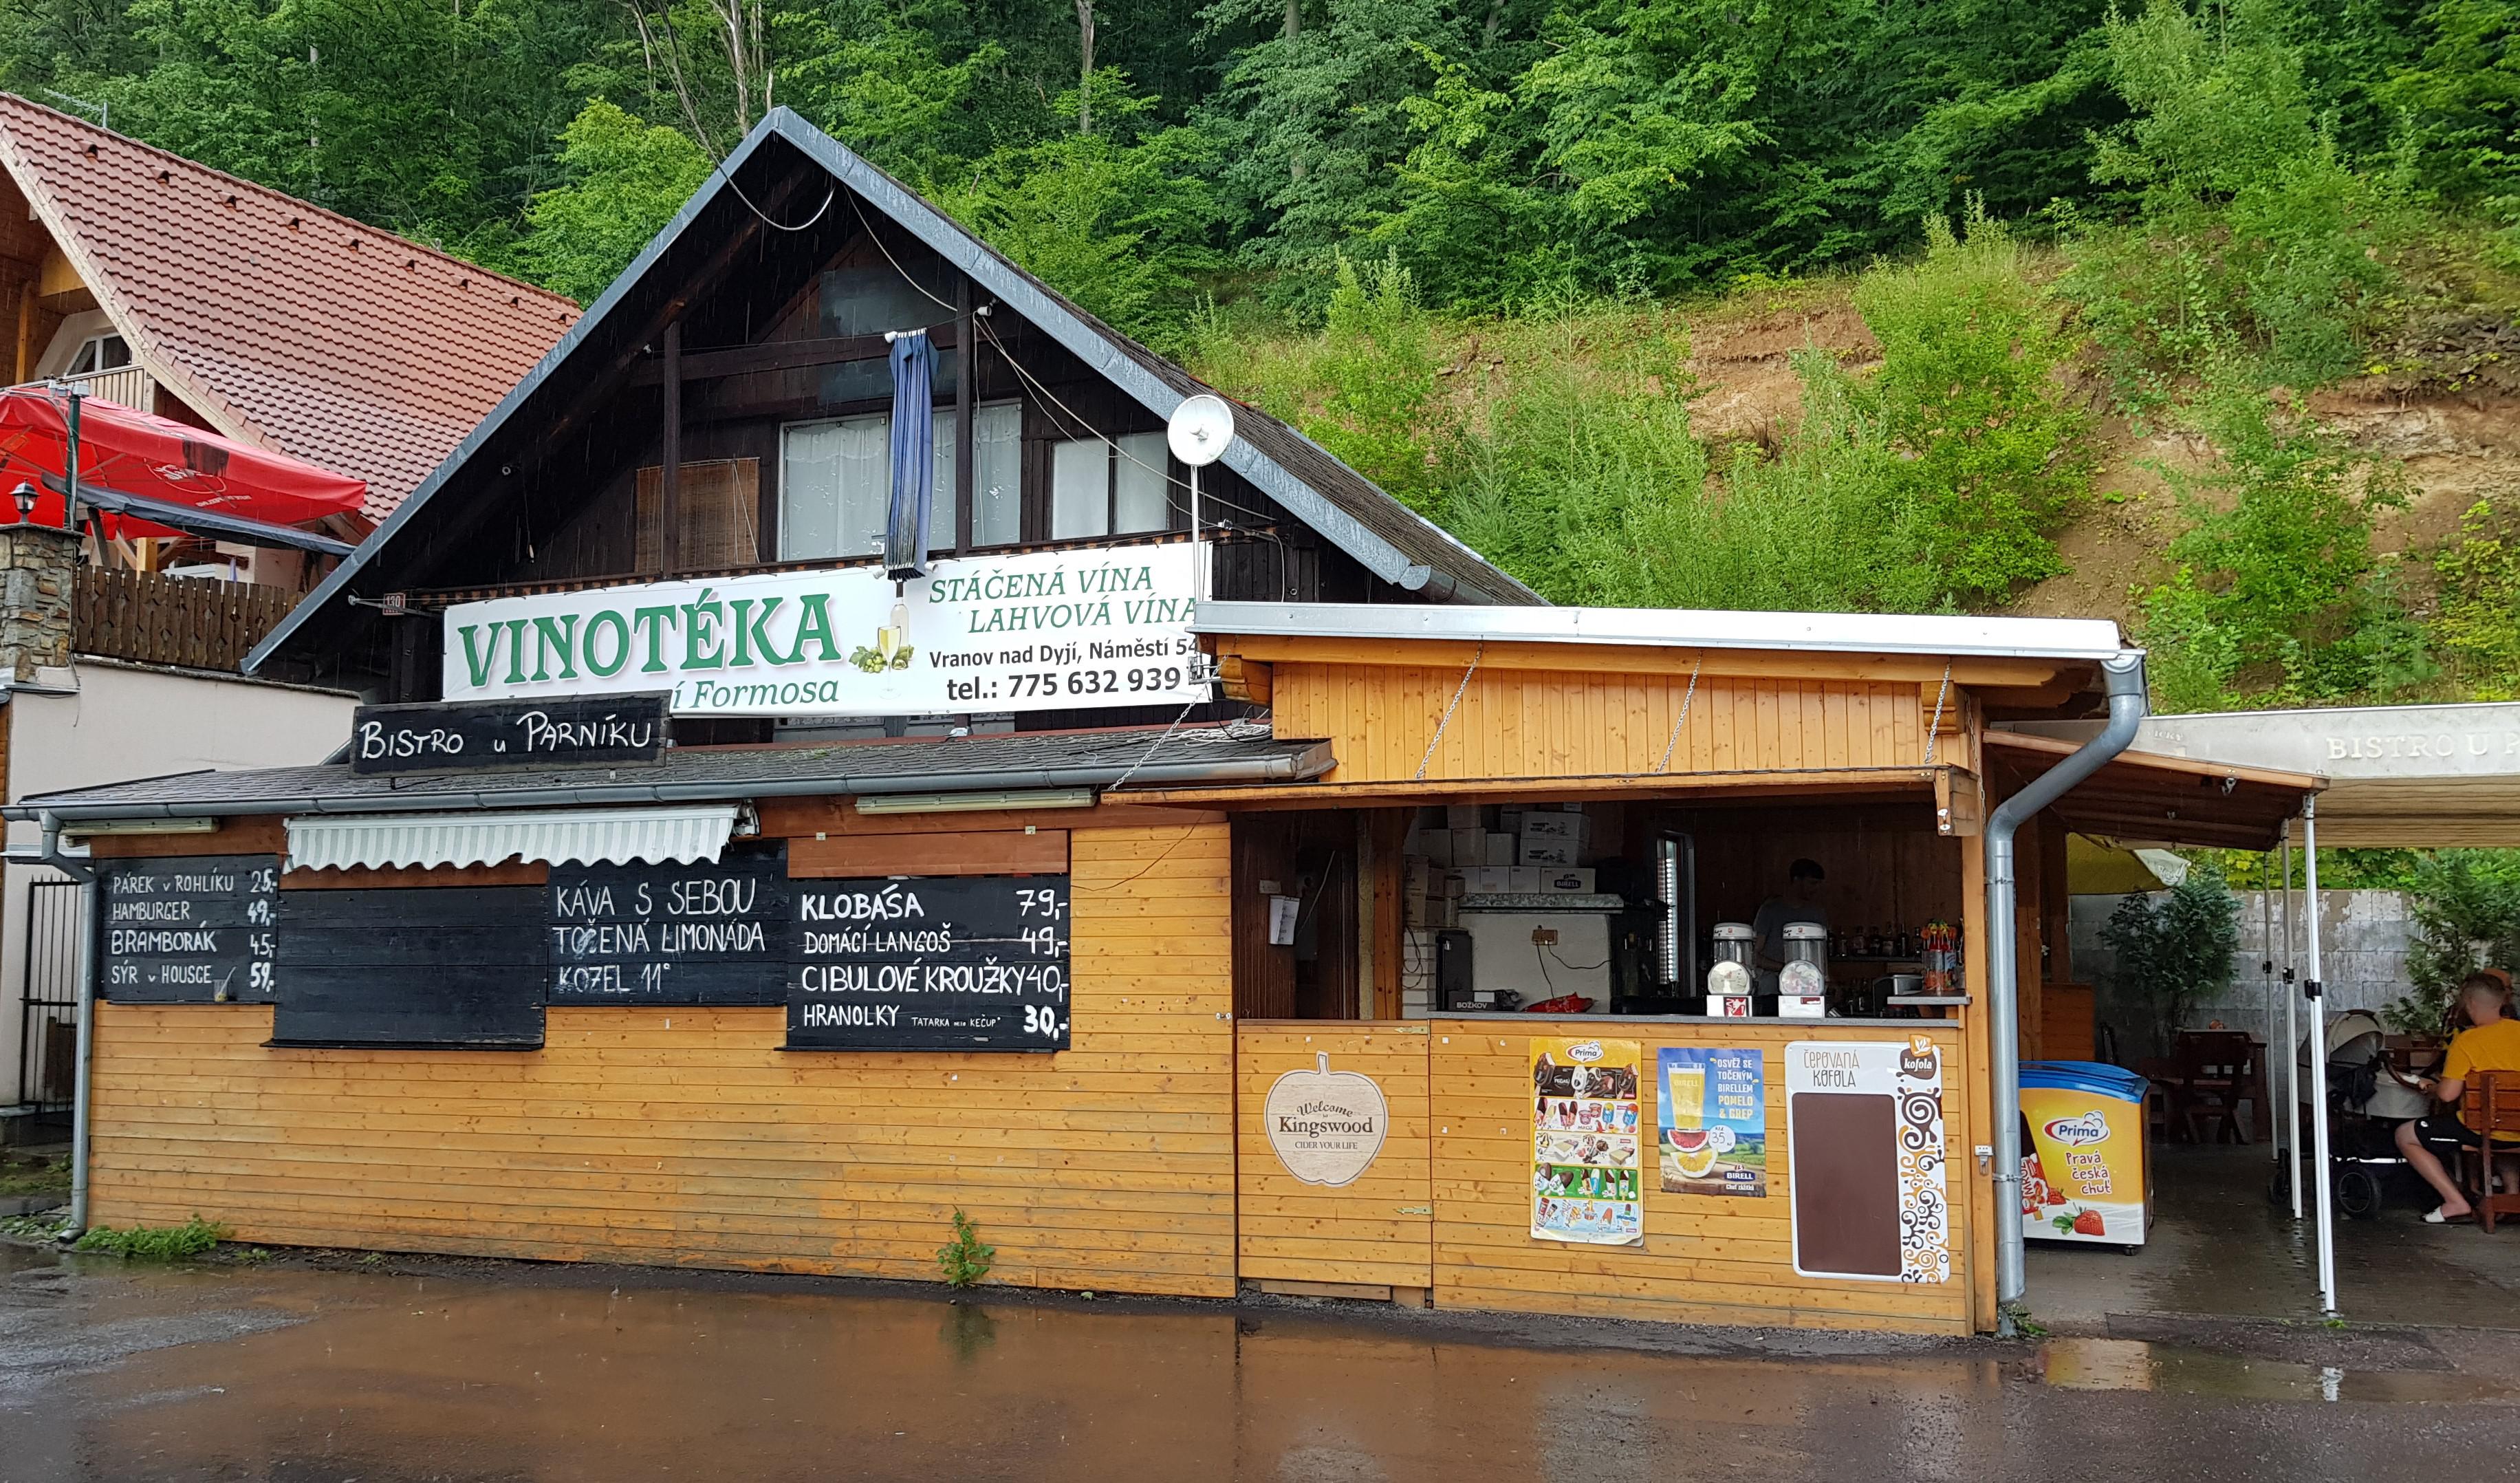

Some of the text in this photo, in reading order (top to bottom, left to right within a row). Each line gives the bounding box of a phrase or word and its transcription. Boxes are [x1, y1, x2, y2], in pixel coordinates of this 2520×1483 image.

[928, 562, 1153, 604] STÁČENÁ VÍNA
[386, 596, 400, 607] 130
[968, 593, 1195, 634] LAHVOVÁ VÍNA
[458, 588, 841, 687] VINOTÉKA
[929, 649, 993, 669] Vranov
[1000, 647, 1032, 665] nad
[1041, 642, 1082, 666] Dyjí,
[1089, 638, 1169, 660] Náměstí
[688, 680, 839, 708] Formosa
[947, 667, 1181, 700] tel.: 775 632 939
[360, 711, 651, 758] BISTRO u PARNÍKU
[2326, 733, 2454, 759] BISTRO
[2465, 732, 2491, 756] U
[113, 872, 155, 894] PÁREK
[175, 867, 234, 893] ROHLÍKU
[557, 878, 756, 917] KÁVA S SEBOU
[801, 883, 924, 921] KLOBÁSA
[113, 901, 191, 920] HAMBURGER
[111, 920, 217, 955] BRAMBORÁK
[662, 918, 765, 953] LIMONÁDA
[803, 922, 871, 954] DOMÁCÍ
[876, 922, 952, 953] LANGOŠ
[111, 959, 138, 984] SÝR
[161, 965, 212, 984] HOUSCE
[802, 957, 922, 993] CIBULOVÉ
[925, 955, 1026, 995] KROUŽKY
[804, 1004, 900, 1027] HRANOLKY
[911, 1017, 950, 1027] TATARKA
[1456, 1001, 1488, 1009] BOŽKOV
[1575, 1049, 1597, 1057] Prima
[1717, 1057, 1752, 1068] OSVĚŽ SE
[1717, 1070, 1753, 1080] TOČENÝM
[1904, 1058, 1933, 1072] kofola
[1717, 1083, 1753, 1093] BIRELLEM
[1813, 1070, 1856, 1087] KOFOLA
[1297, 1101, 1353, 1117] Welcome
[1718, 1096, 1753, 1106] POMELO
[1729, 1109, 1753, 1119] GREP
[1279, 1116, 1373, 1138] Kingswood
[2059, 1125, 2098, 1137] Prima
[1295, 1141, 1318, 1149] CIDER
[1319, 1141, 1340, 1149] YOUR
[2065, 1149, 2102, 1165] Pravá
[2072, 1165, 2109, 1180] česká
[2081, 1180, 2111, 1194] chuť
